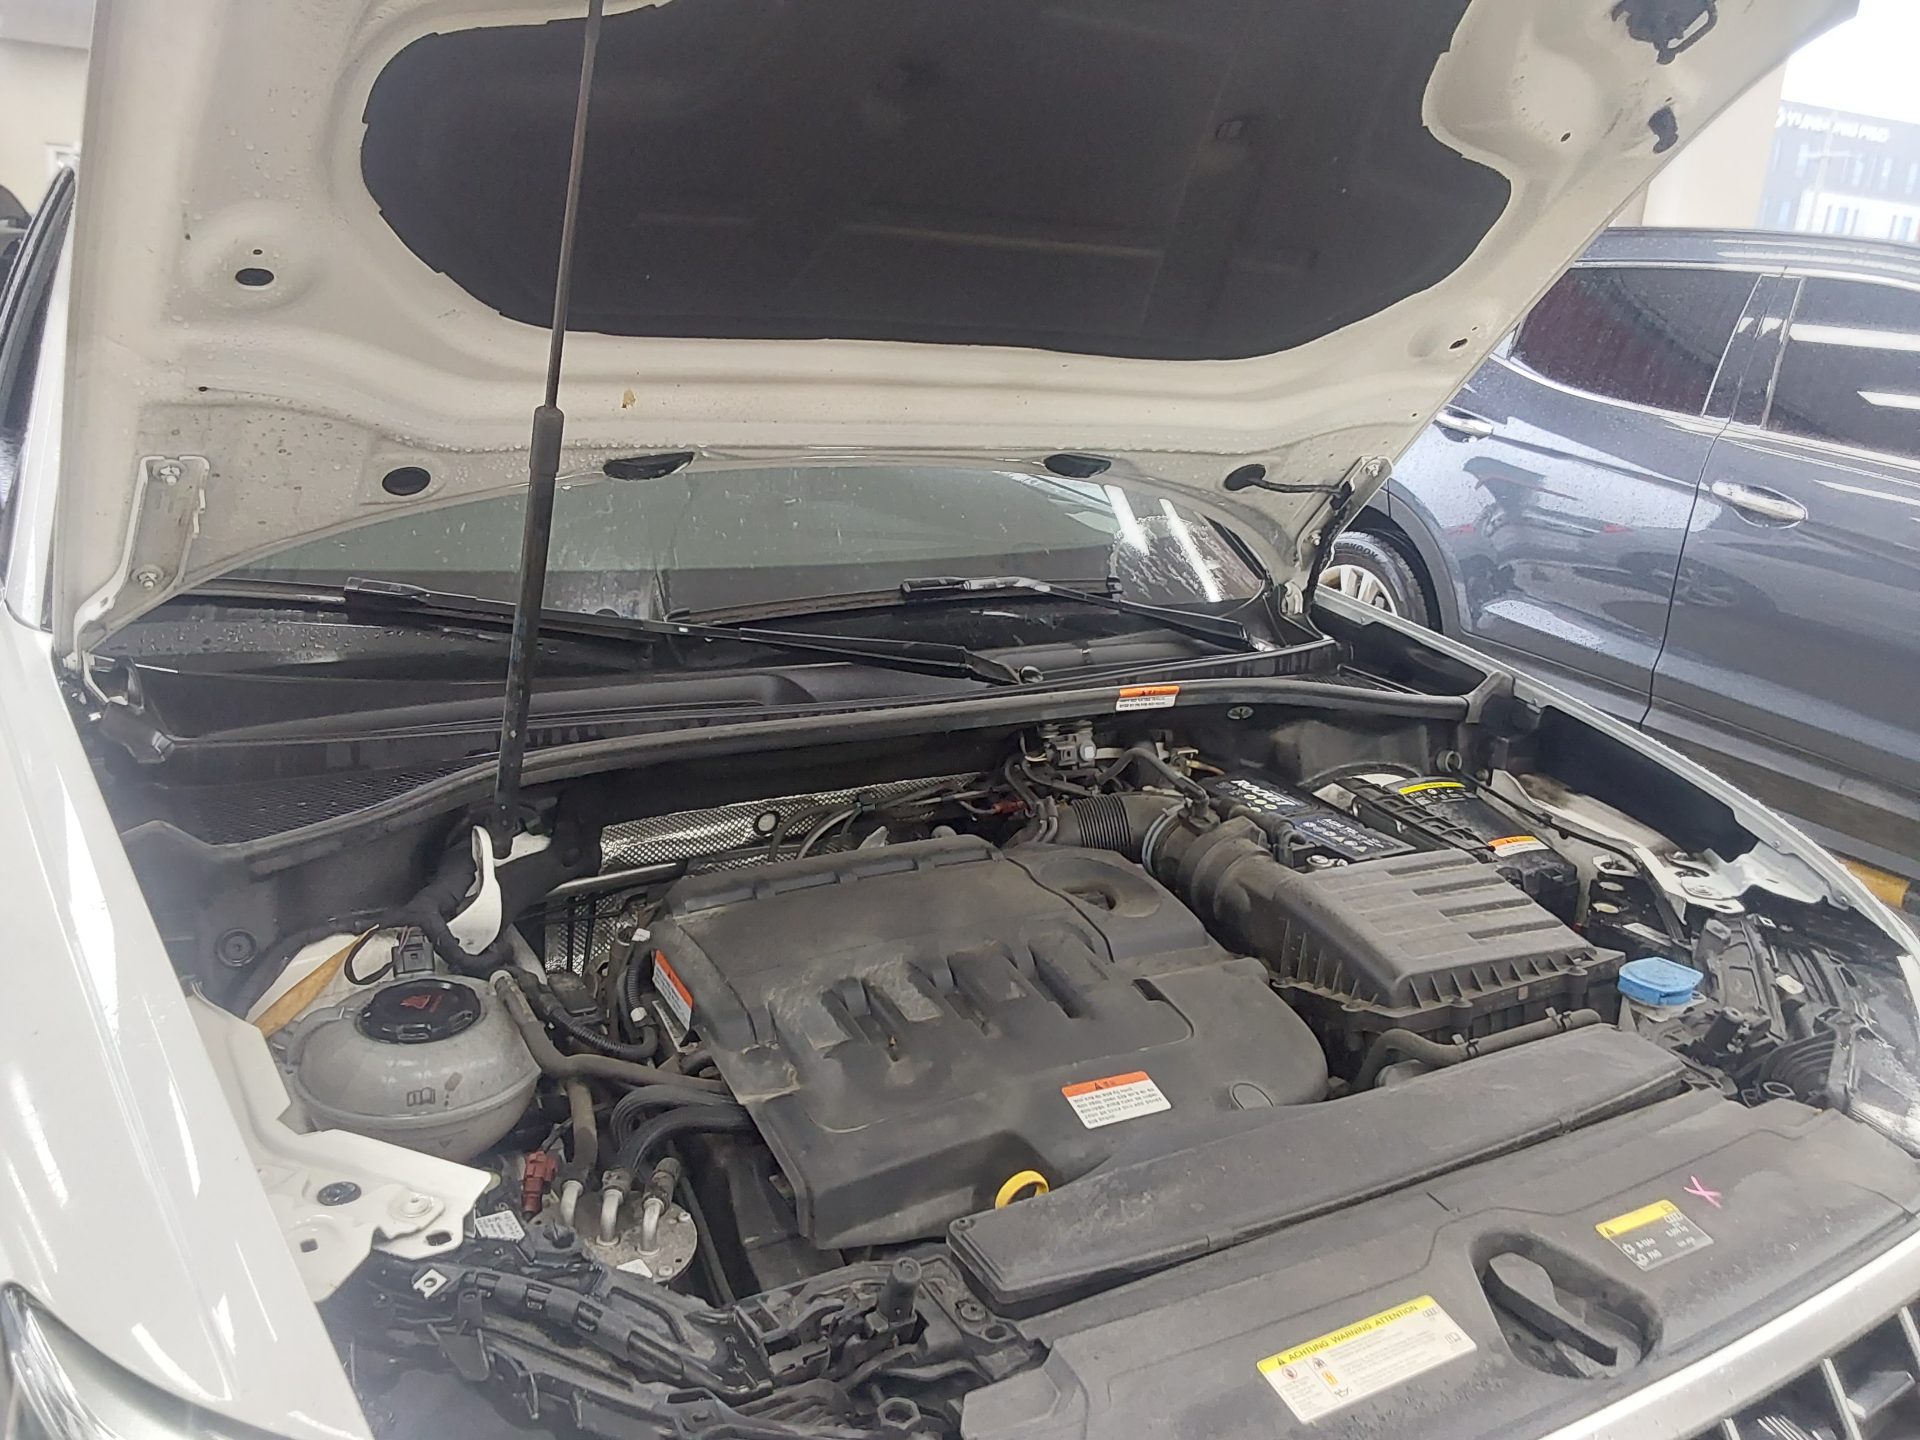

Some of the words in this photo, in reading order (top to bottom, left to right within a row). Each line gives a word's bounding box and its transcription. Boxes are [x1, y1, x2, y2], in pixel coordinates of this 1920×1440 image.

[1231, 780, 1296, 806] ROCKET
[1288, 1340, 1329, 1361] ACHTUNG
[1332, 1324, 1372, 1344] WARNING
[1374, 1305, 1418, 1326] ATTENTION
